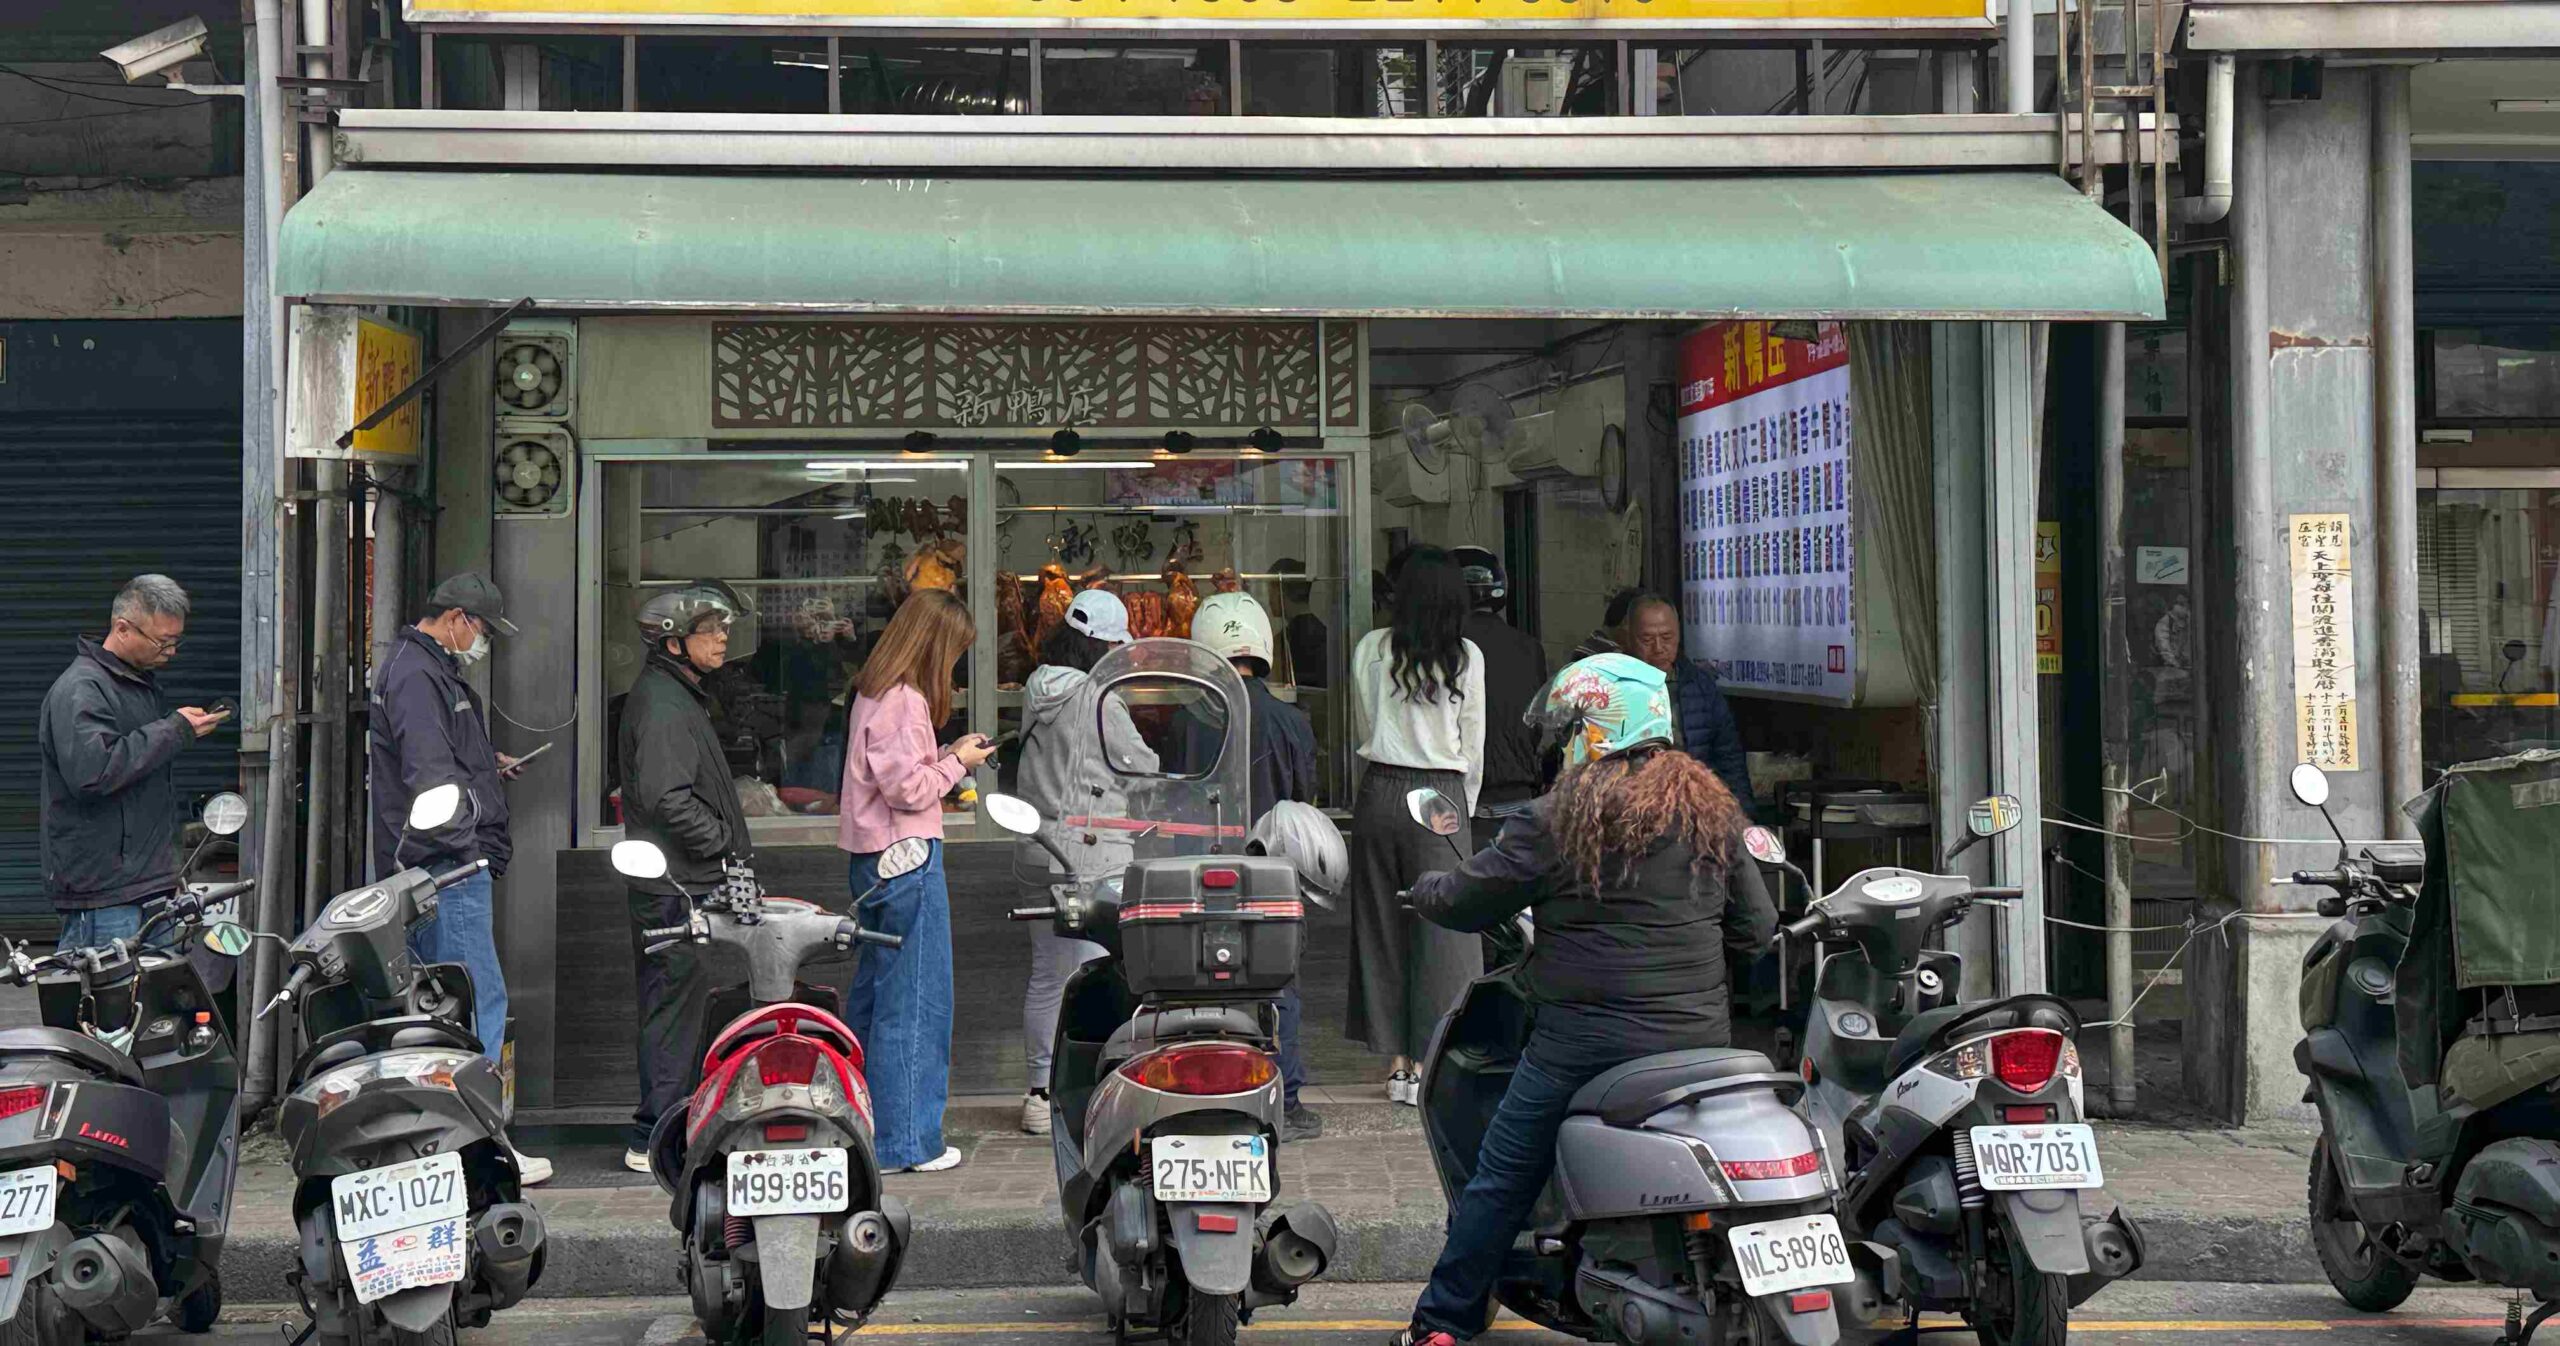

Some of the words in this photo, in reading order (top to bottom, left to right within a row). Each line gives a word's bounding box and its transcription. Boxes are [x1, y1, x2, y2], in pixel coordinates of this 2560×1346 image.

[953, 383, 1098, 427] 新鴨庄
[0, 1184, 49, 1220] 277
